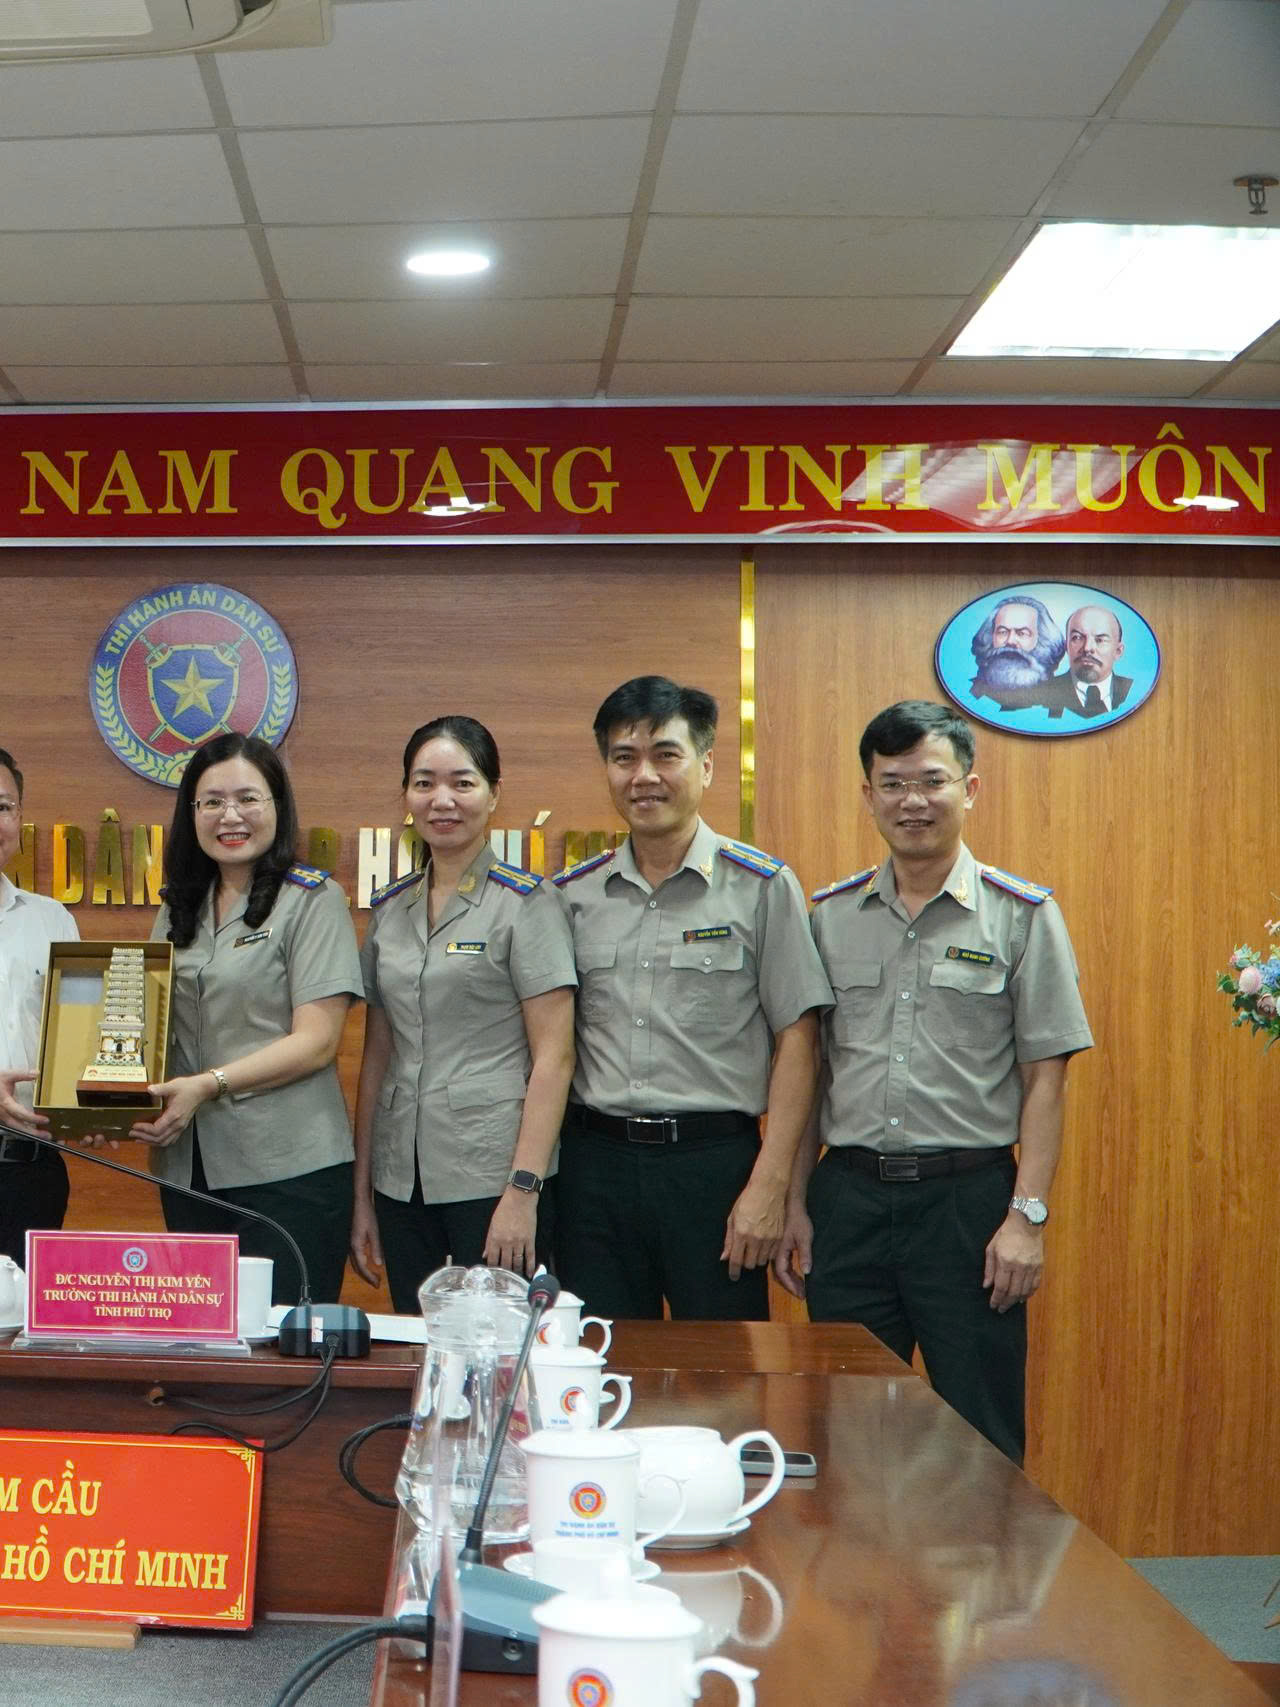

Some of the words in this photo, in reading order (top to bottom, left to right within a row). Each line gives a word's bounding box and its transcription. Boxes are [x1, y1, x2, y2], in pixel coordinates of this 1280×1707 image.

[20, 448, 238, 514] NAM
[280, 446, 620, 529] QUANG
[664, 443, 931, 512] VINH
[976, 422, 1273, 514] MUÔN
[105, 622, 132, 655] THI
[128, 591, 184, 628] HÀNH
[188, 585, 217, 606] ÁN
[221, 594, 263, 629] DÂN
[53, 808, 163, 905] DÂN
[43, 1287, 96, 1302] TRƯỞNG
[98, 1290, 121, 1302] THI
[122, 1289, 157, 1303] HÀNH
[159, 1290, 178, 1304] ÁN
[179, 1291, 205, 1305] DÂN
[207, 1293, 225, 1308] SỰ
[55, 1273, 77, 1286] Đ/C
[78, 1272, 131, 1287] NGUYỄN
[133, 1275, 155, 1290] THỊ
[157, 1275, 183, 1288] KIM
[123, 1304, 146, 1317] PHÚ
[148, 1307, 172, 1320] THỌ
[31, 1459, 102, 1517] CẦU
[0, 1525, 52, 1582] HỒ
[63, 1538, 127, 1587] CHÍ
[135, 1550, 229, 1590] MINH
